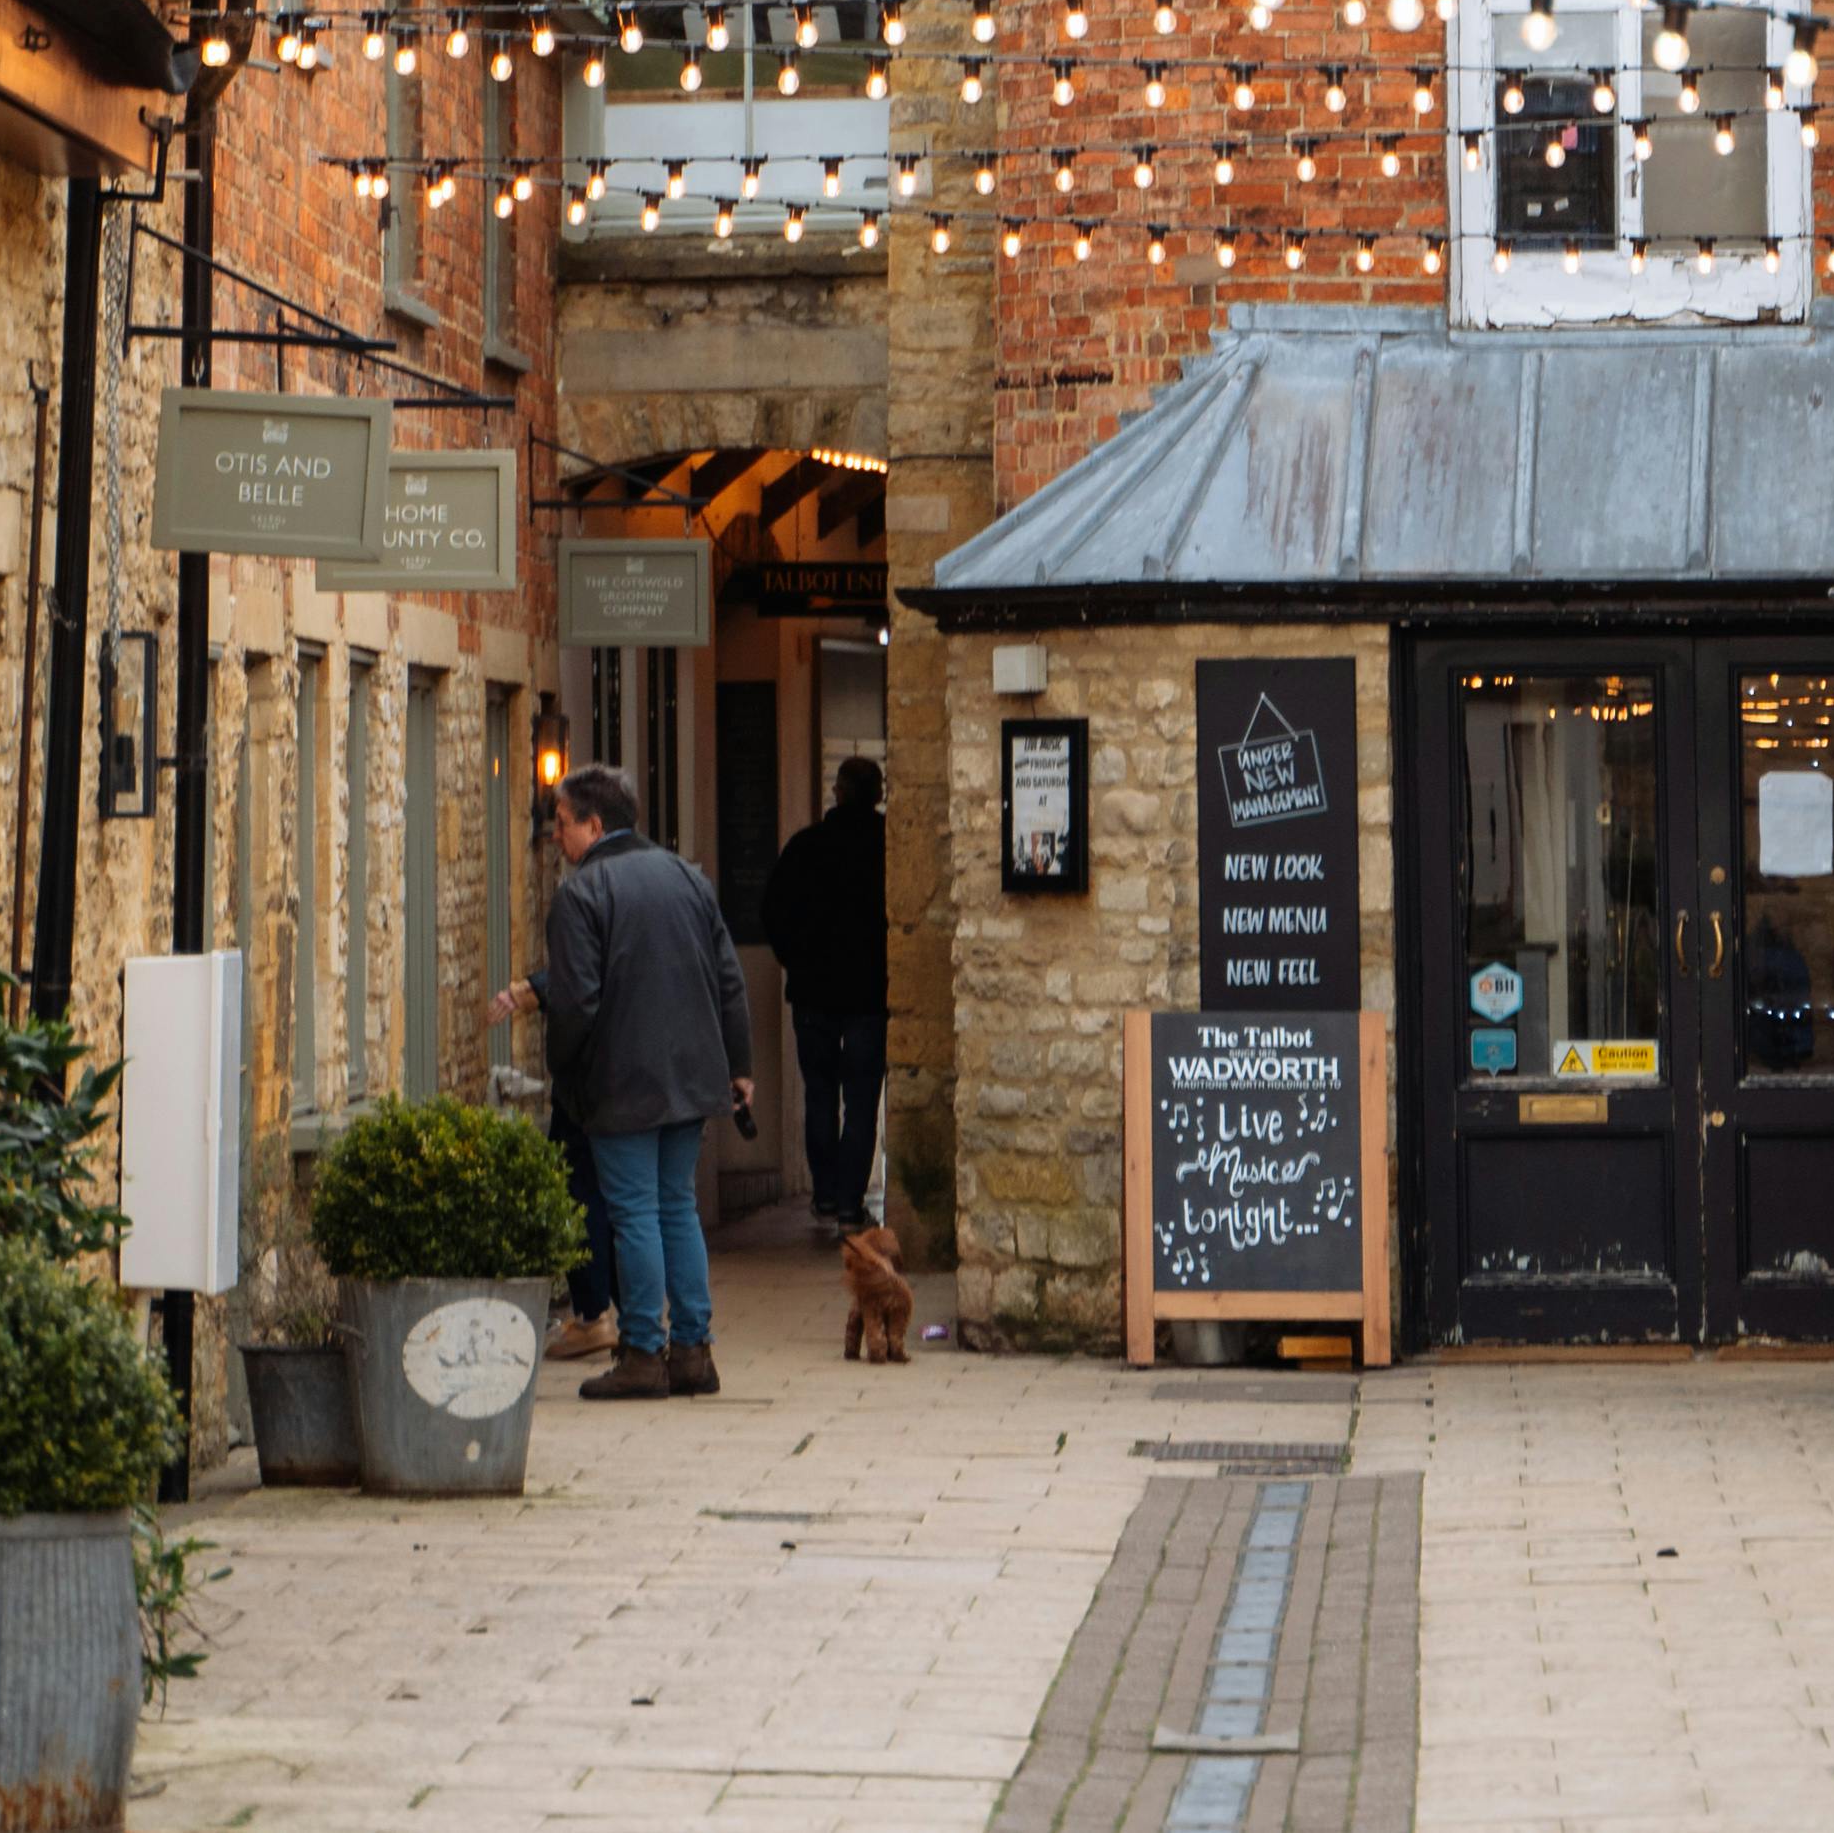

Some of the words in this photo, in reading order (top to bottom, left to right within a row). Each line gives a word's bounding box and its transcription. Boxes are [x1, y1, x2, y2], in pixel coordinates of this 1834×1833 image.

[215, 451, 268, 475] OTIS
[274, 457, 332, 479] AND
[238, 481, 304, 507] BELLE
[385, 504, 448, 524] HOME
[585, 576, 608, 588] THE
[612, 576, 684, 588] COTSWOLD
[762, 570, 839, 592] TALBOT
[603, 604, 665, 616] COMPANY
[1237, 742, 1294, 771] UNDER
[1242, 760, 1296, 794] NEW
[1231, 783, 1320, 822] MANAGEMENT
[1224, 853, 1269, 882] NEW
[1273, 853, 1325, 882] LOOK
[1223, 907, 1264, 934] NEW
[1268, 907, 1327, 934] MENU
[1226, 958, 1270, 987] NEW
[1278, 957, 1321, 986] FEEL
[1198, 1026, 1239, 1048] The
[1243, 1026, 1313, 1048] Talbot
[1598, 1047, 1648, 1060] Caution
[1168, 1056, 1338, 1082] WADWORTH
[1172, 1079, 1228, 1091] TRADITIONS
[1230, 1079, 1265, 1091] WORTH
[1219, 1102, 1284, 1145] Live
